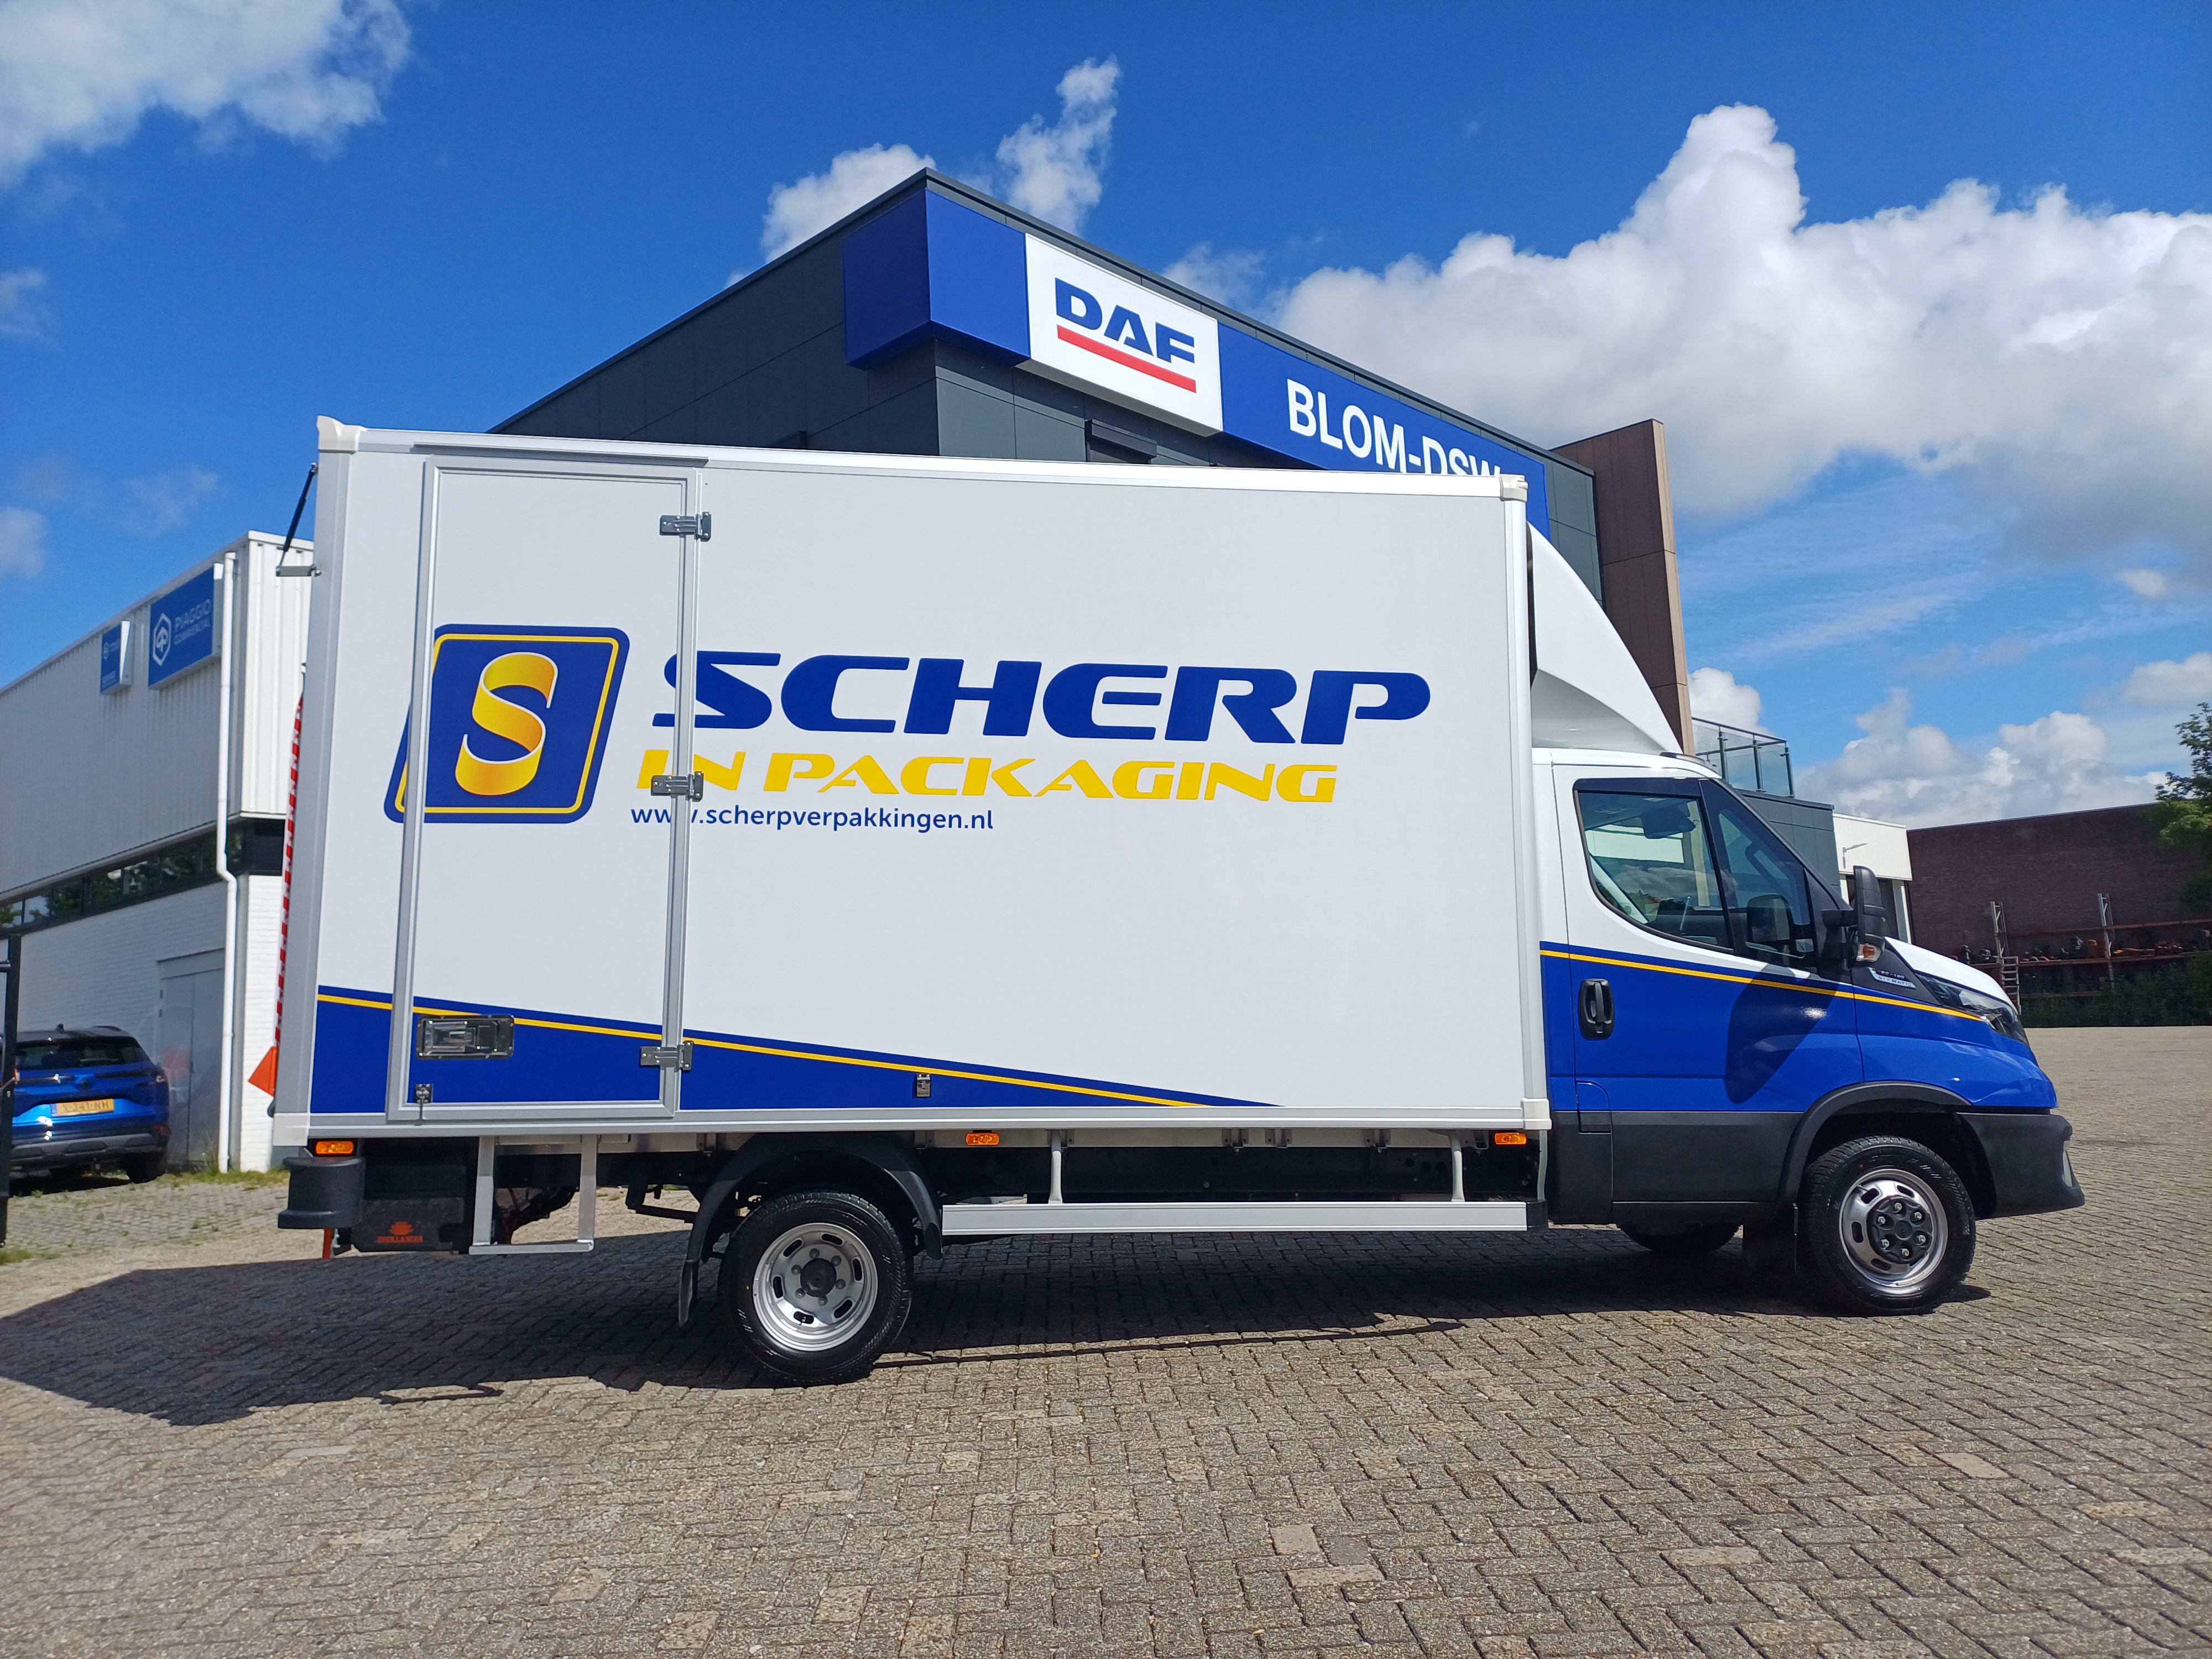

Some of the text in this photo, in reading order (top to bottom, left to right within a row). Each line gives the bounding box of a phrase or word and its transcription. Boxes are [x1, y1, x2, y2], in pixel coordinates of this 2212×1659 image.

[1055, 277, 1195, 363] DAF
[175, 599, 211, 632] PIAGGIO
[455, 651, 558, 796] S
[653, 650, 1431, 745] SCHERP
[763, 752, 1338, 802] PACKAGING
